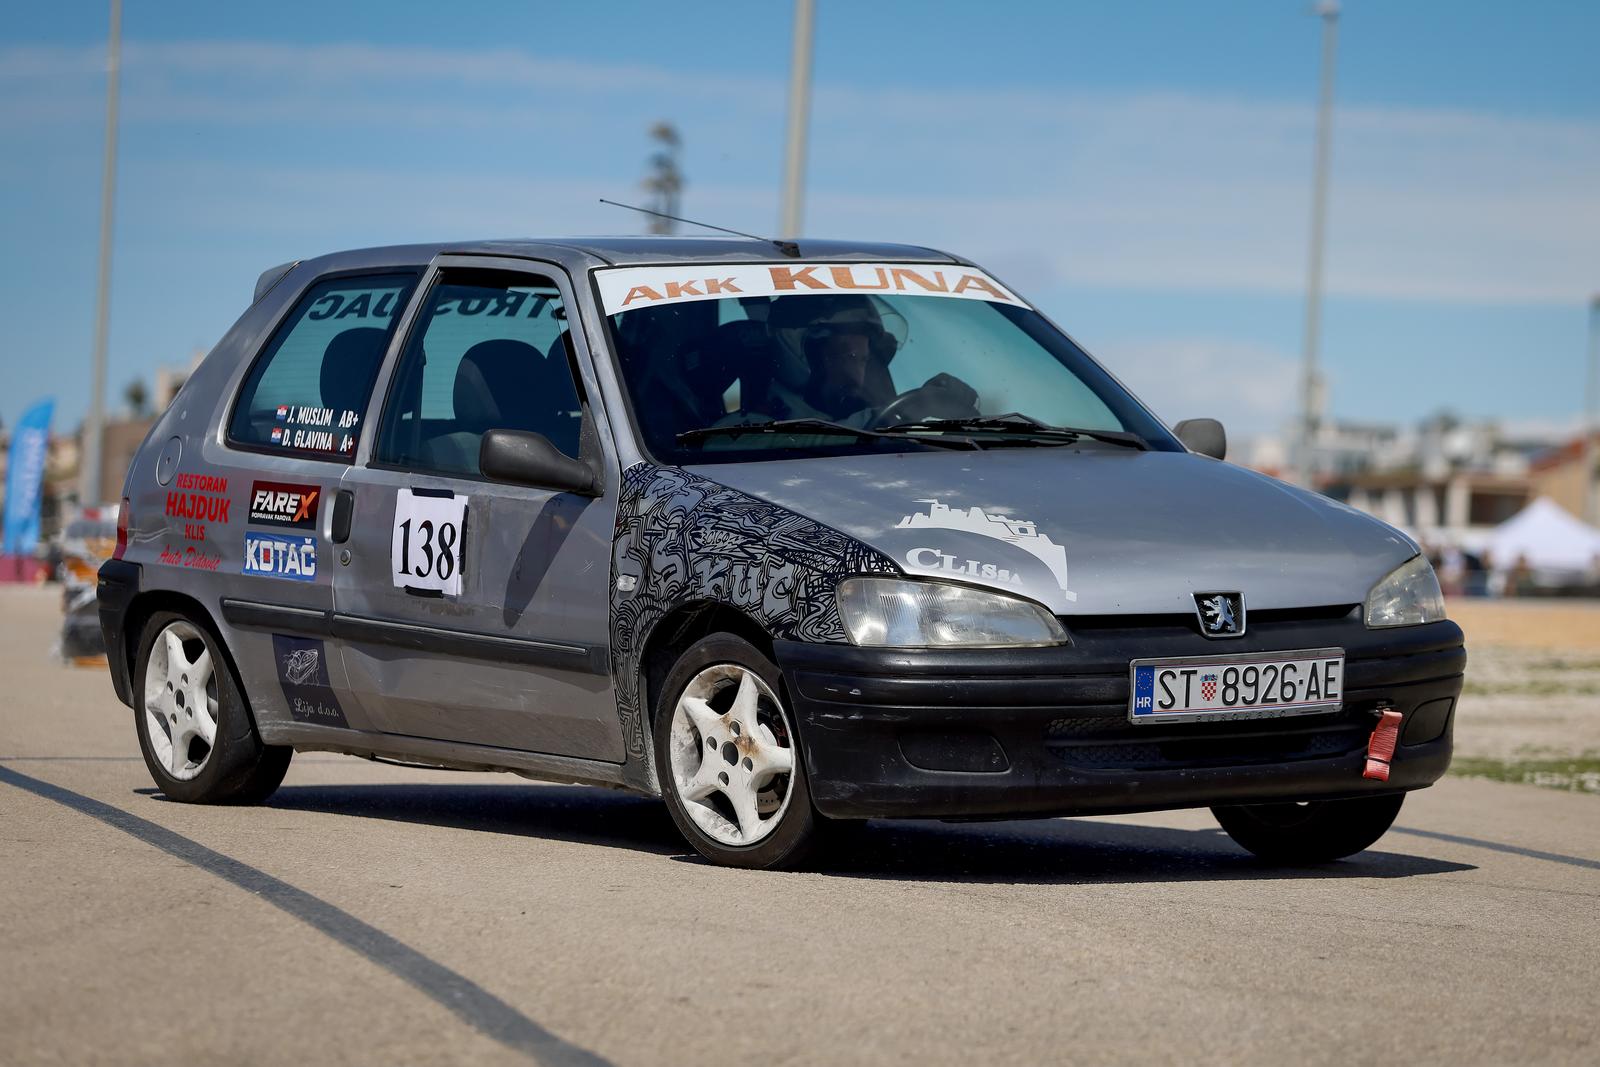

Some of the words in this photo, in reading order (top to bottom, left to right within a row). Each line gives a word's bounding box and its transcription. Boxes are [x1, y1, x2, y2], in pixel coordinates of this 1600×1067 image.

[620, 276, 744, 306] AKK
[767, 266, 1017, 301] KUNA
[286, 405, 295, 424] J.
[296, 406, 334, 427] MUSLIM
[338, 410, 359, 428] AB+
[281, 428, 291, 447] D.
[293, 429, 333, 451] GLAVINA
[339, 433, 354, 452] A+
[176, 472, 227, 494] RESTORAN
[165, 491, 231, 524] HAJDUK
[252, 490, 318, 522] FAREX
[184, 523, 205, 541] KLIS
[245, 537, 316, 576] KOTAČ
[398, 518, 456, 580] 138
[1136, 696, 1151, 708] HR
[1158, 669, 1198, 709] ST
